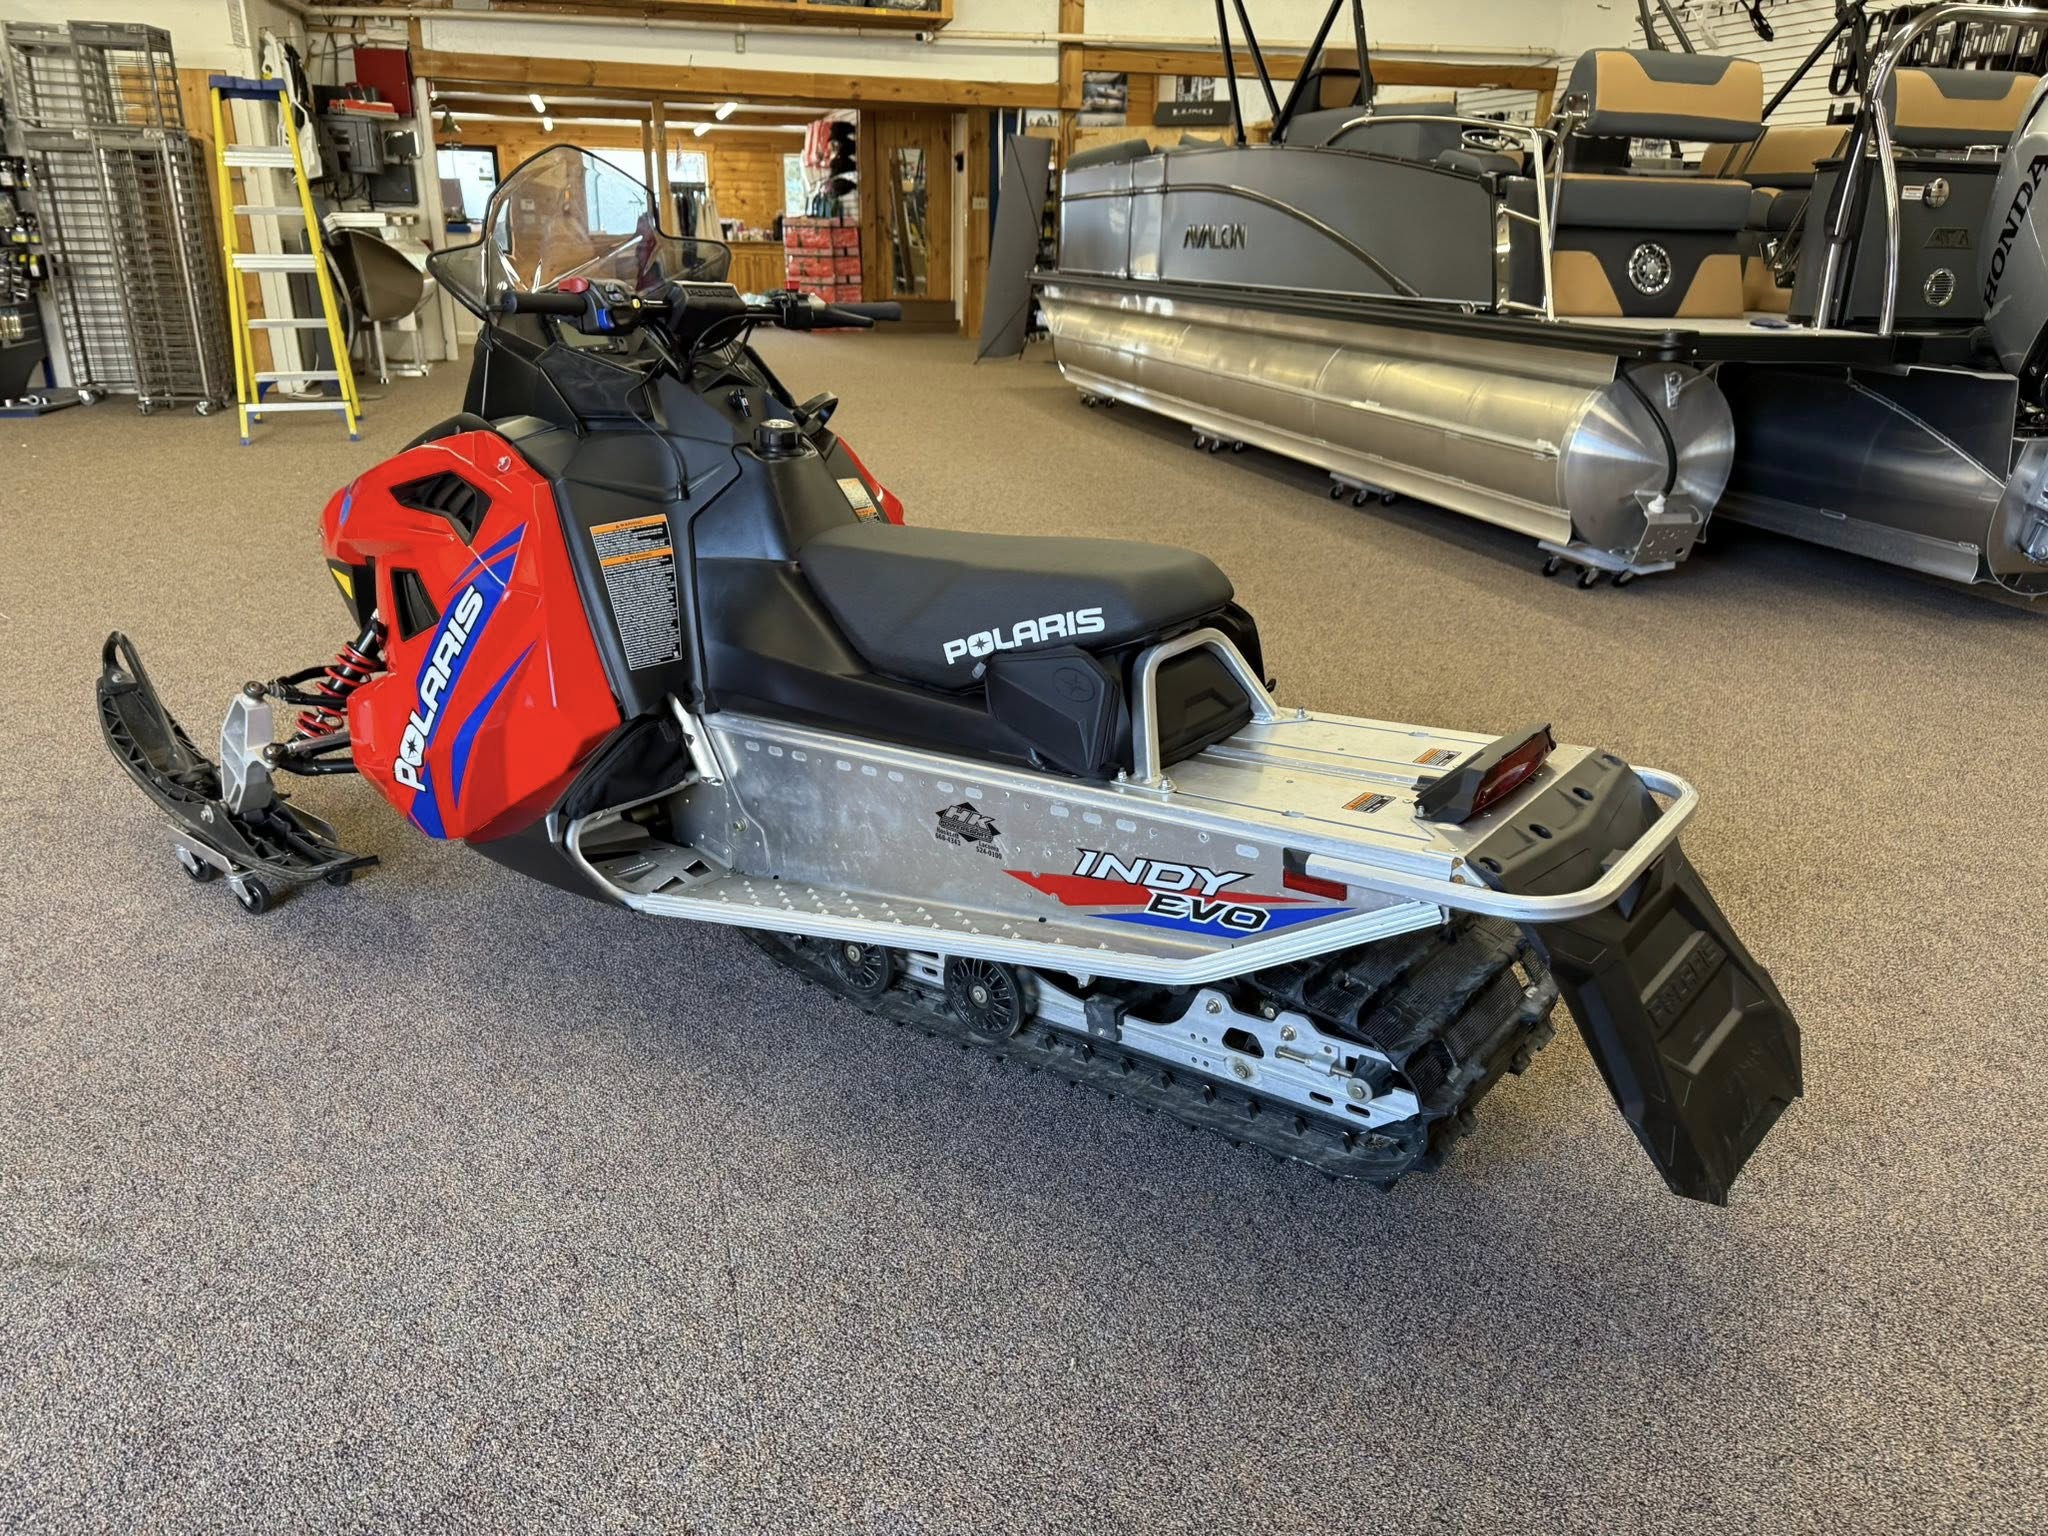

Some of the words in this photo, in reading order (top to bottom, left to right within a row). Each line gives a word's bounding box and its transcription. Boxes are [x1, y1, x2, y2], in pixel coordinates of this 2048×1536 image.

[1183, 224, 1248, 249] AVALON
[1983, 155, 2048, 312] HONDA
[942, 607, 1106, 665] POLARIS
[393, 584, 484, 792] POLARIS
[1071, 848, 1255, 897] INDY
[1143, 888, 1271, 933] EVO
